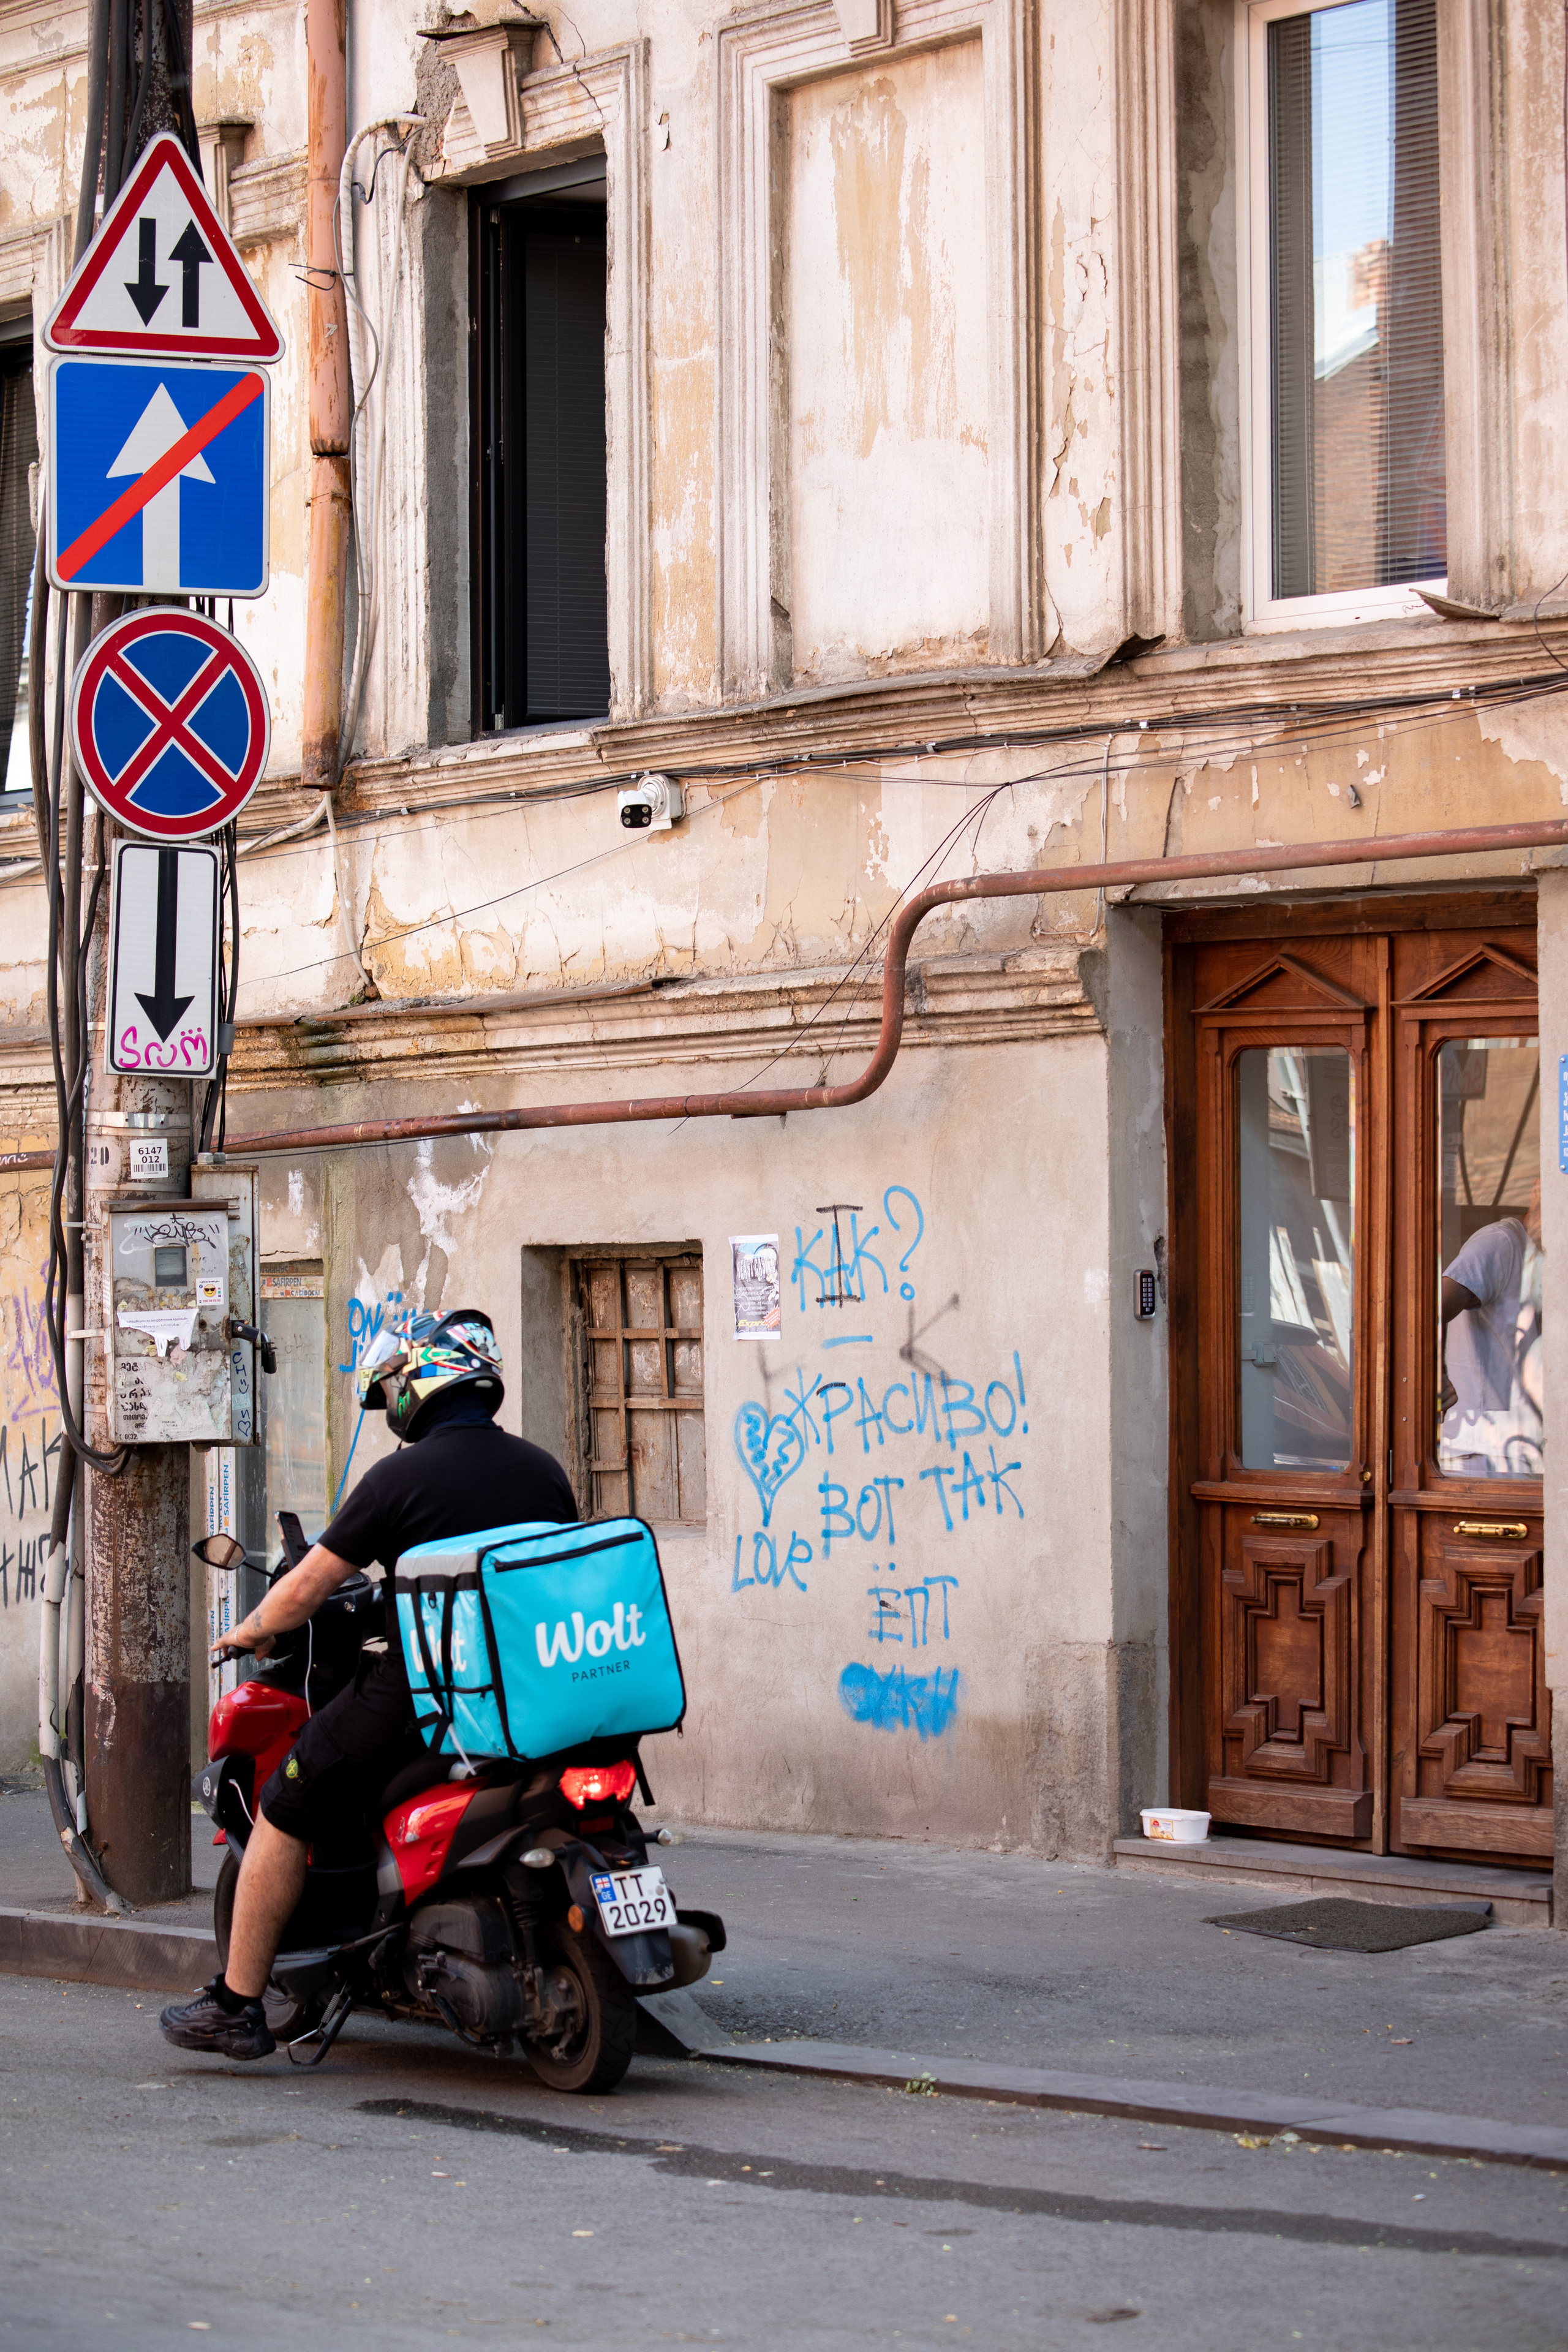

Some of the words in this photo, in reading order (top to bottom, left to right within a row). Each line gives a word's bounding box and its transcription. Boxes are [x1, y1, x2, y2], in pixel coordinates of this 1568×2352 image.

[818, 1471, 904, 1559] ВОТ
[919, 1446, 1024, 1531] ТАК
[410, 1625, 467, 1673] Wt
[535, 1602, 647, 1668] Wolt
[571, 1660, 630, 1683] PARTNER
[601, 1890, 612, 1900] GE
[614, 1874, 643, 1900] TT
[609, 1898, 666, 1929] 2029
